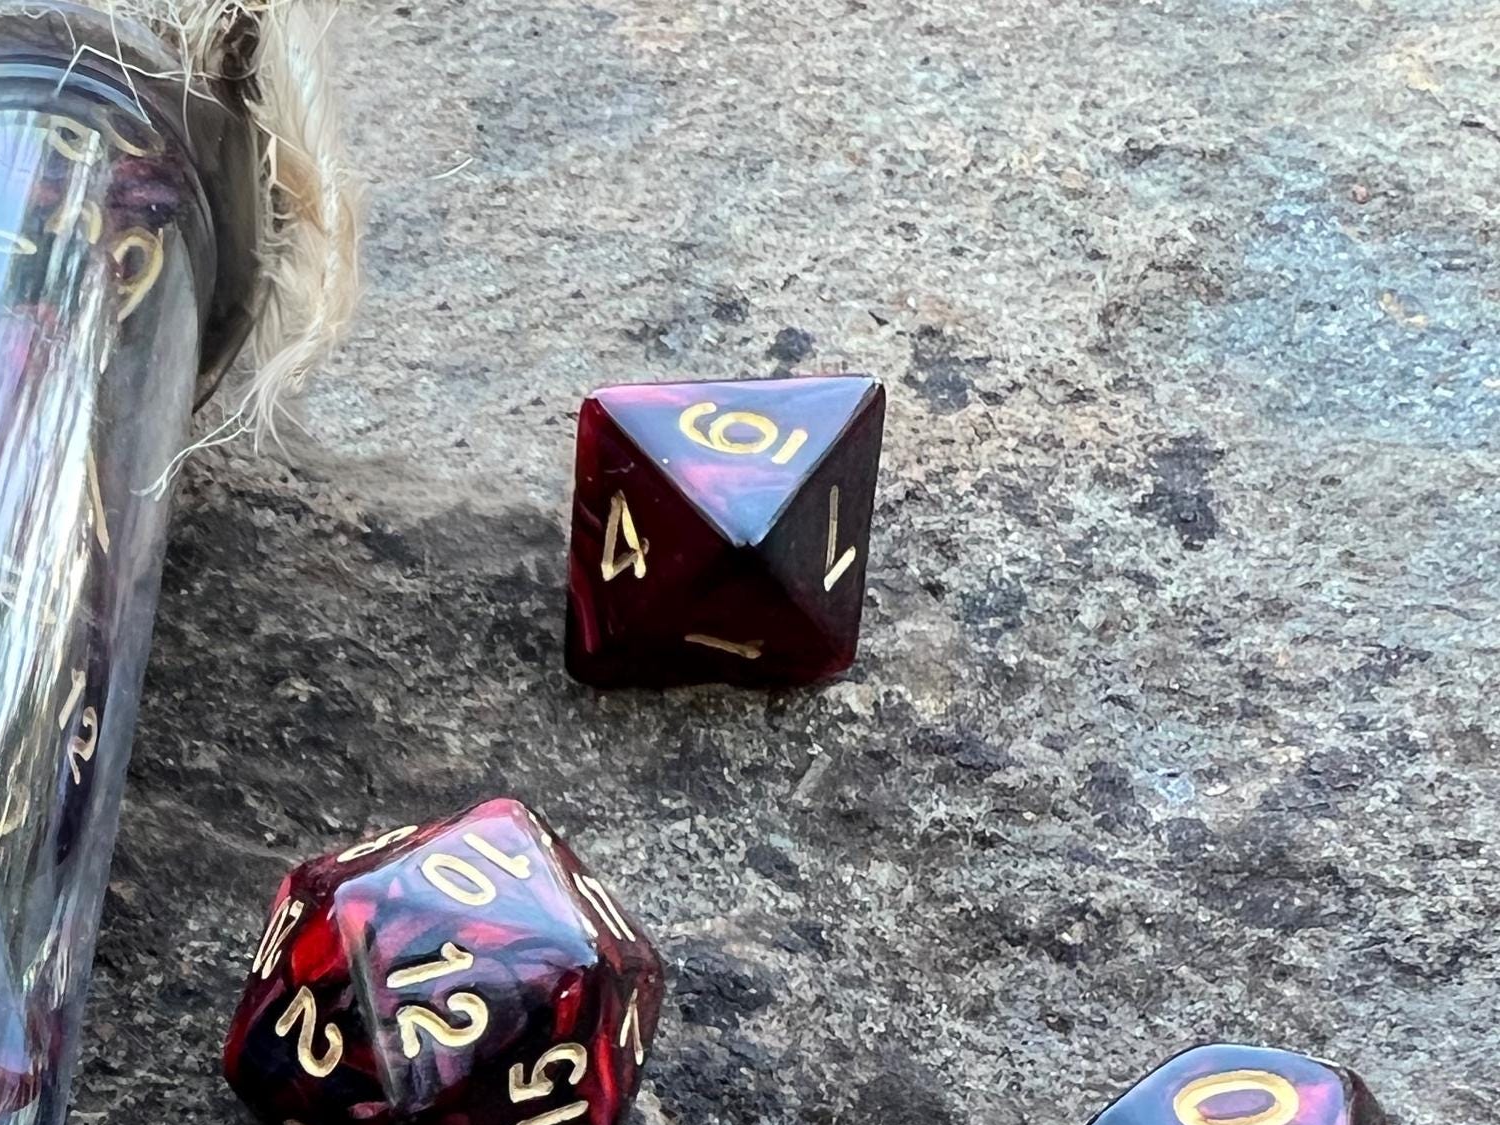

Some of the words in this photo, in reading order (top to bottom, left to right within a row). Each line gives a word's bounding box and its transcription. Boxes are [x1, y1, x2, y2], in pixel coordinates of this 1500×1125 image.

[600, 488, 651, 583] 4
[421, 833, 532, 907] 10
[275, 984, 344, 1079] 2
[386, 940, 490, 1060] 12
